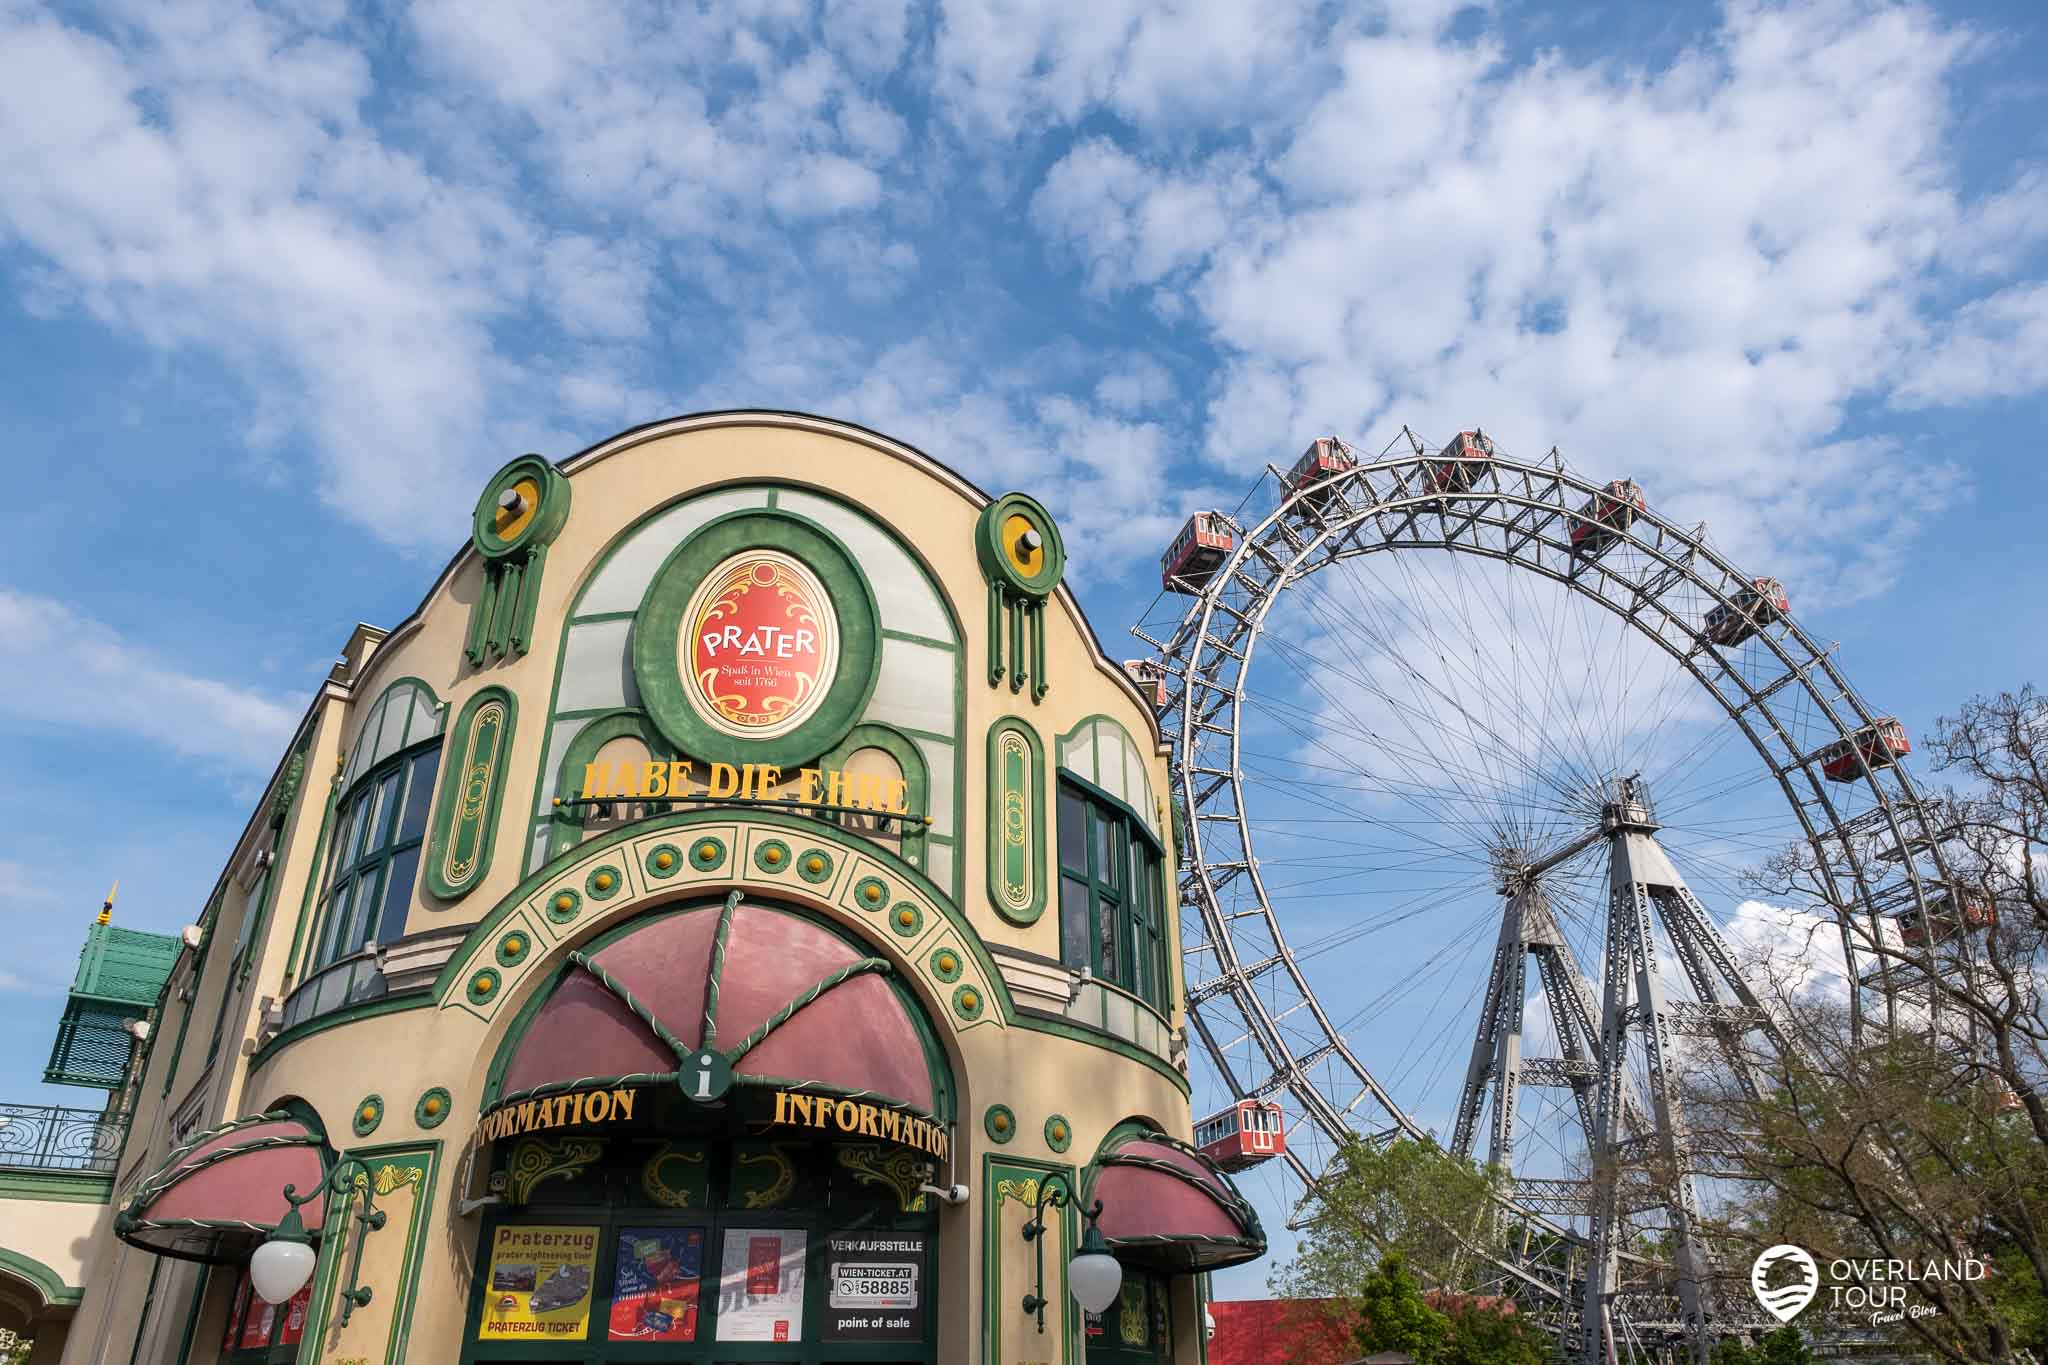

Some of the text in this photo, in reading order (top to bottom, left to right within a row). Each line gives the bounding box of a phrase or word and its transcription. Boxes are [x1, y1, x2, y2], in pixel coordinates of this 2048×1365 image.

[702, 625, 816, 658] PRATER
[721, 664, 791, 677] Spaß in Wien
[734, 677, 751, 686] seit
[580, 760, 909, 815] HABE DIE EHRE
[773, 1091, 949, 1163] INFORMATION
[499, 1229, 595, 1250] Praterzug
[831, 1240, 923, 1251] VERKAUFSSTELLE
[840, 1268, 910, 1278] WIEN-TICKET.AT
[860, 1281, 909, 1294] 58885
[487, 1321, 581, 1333] PRATERZUG TICKET
[838, 1316, 910, 1330] point of sale
